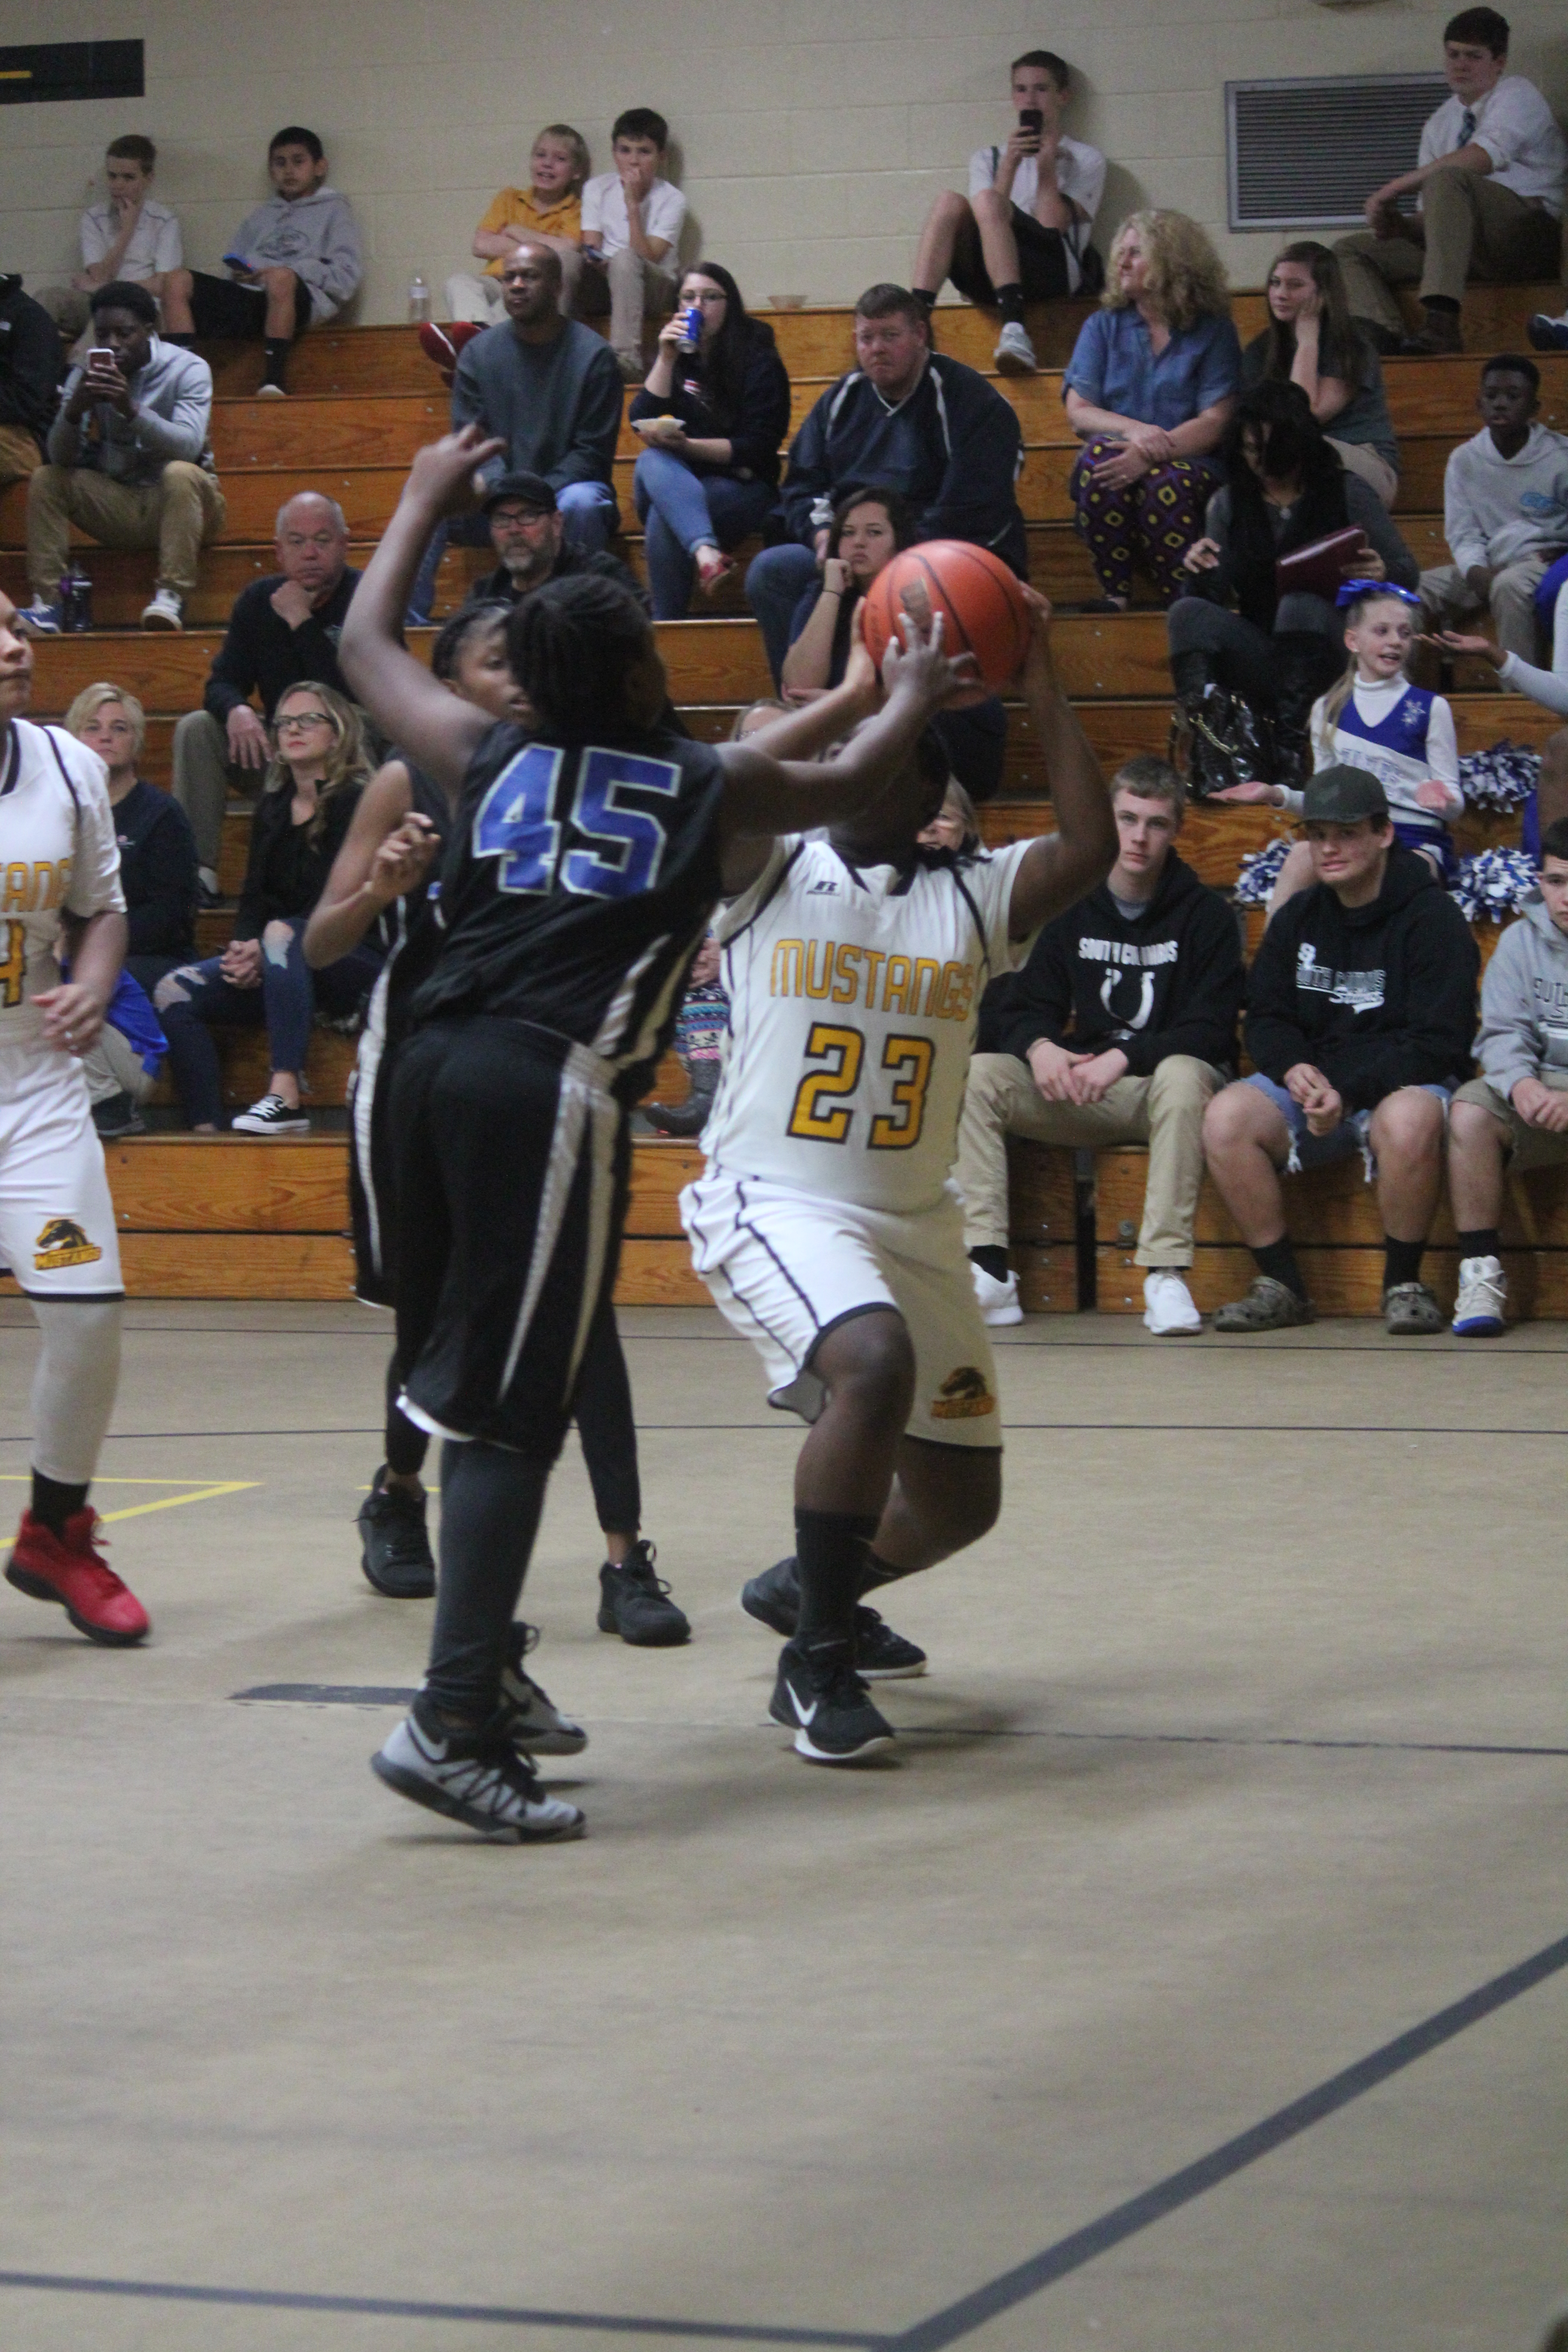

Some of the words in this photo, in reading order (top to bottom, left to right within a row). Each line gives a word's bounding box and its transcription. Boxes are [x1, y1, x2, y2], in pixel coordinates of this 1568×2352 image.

[472, 742, 682, 899] 45
[770, 938, 974, 1021] MUSTANGS
[786, 1021, 936, 1151] 23
